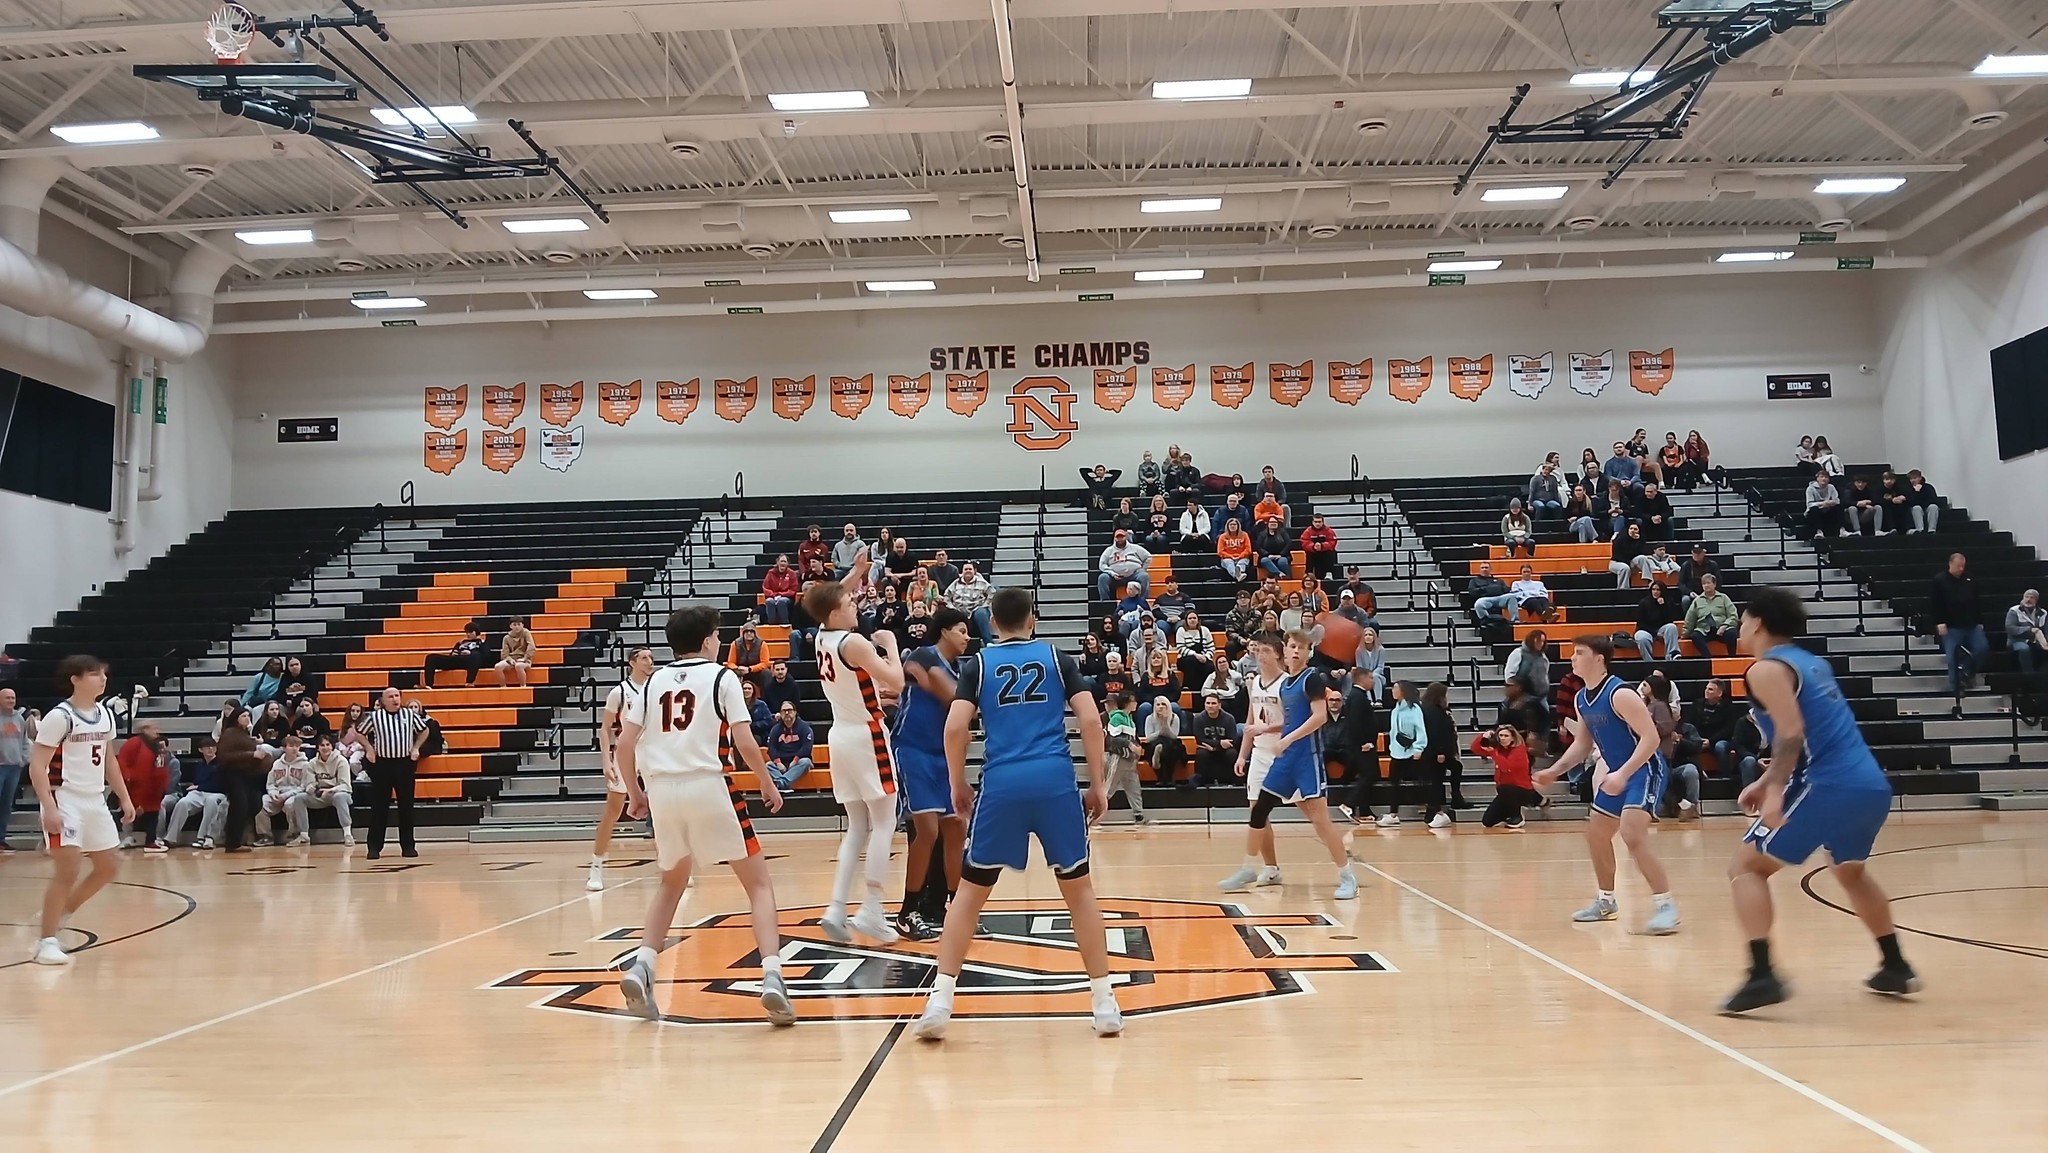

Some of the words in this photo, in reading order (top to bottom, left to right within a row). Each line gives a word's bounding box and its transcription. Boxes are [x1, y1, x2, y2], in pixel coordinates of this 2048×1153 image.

[929, 345, 1016, 371] STATE
[1034, 341, 1150, 369] CHAMPS
[1786, 382, 1811, 390] HOME
[296, 425, 320, 434] HOME
[817, 650, 836, 682] 23
[995, 661, 1048, 707] 22
[658, 689, 697, 733] 13
[91, 744, 102, 767] 5
